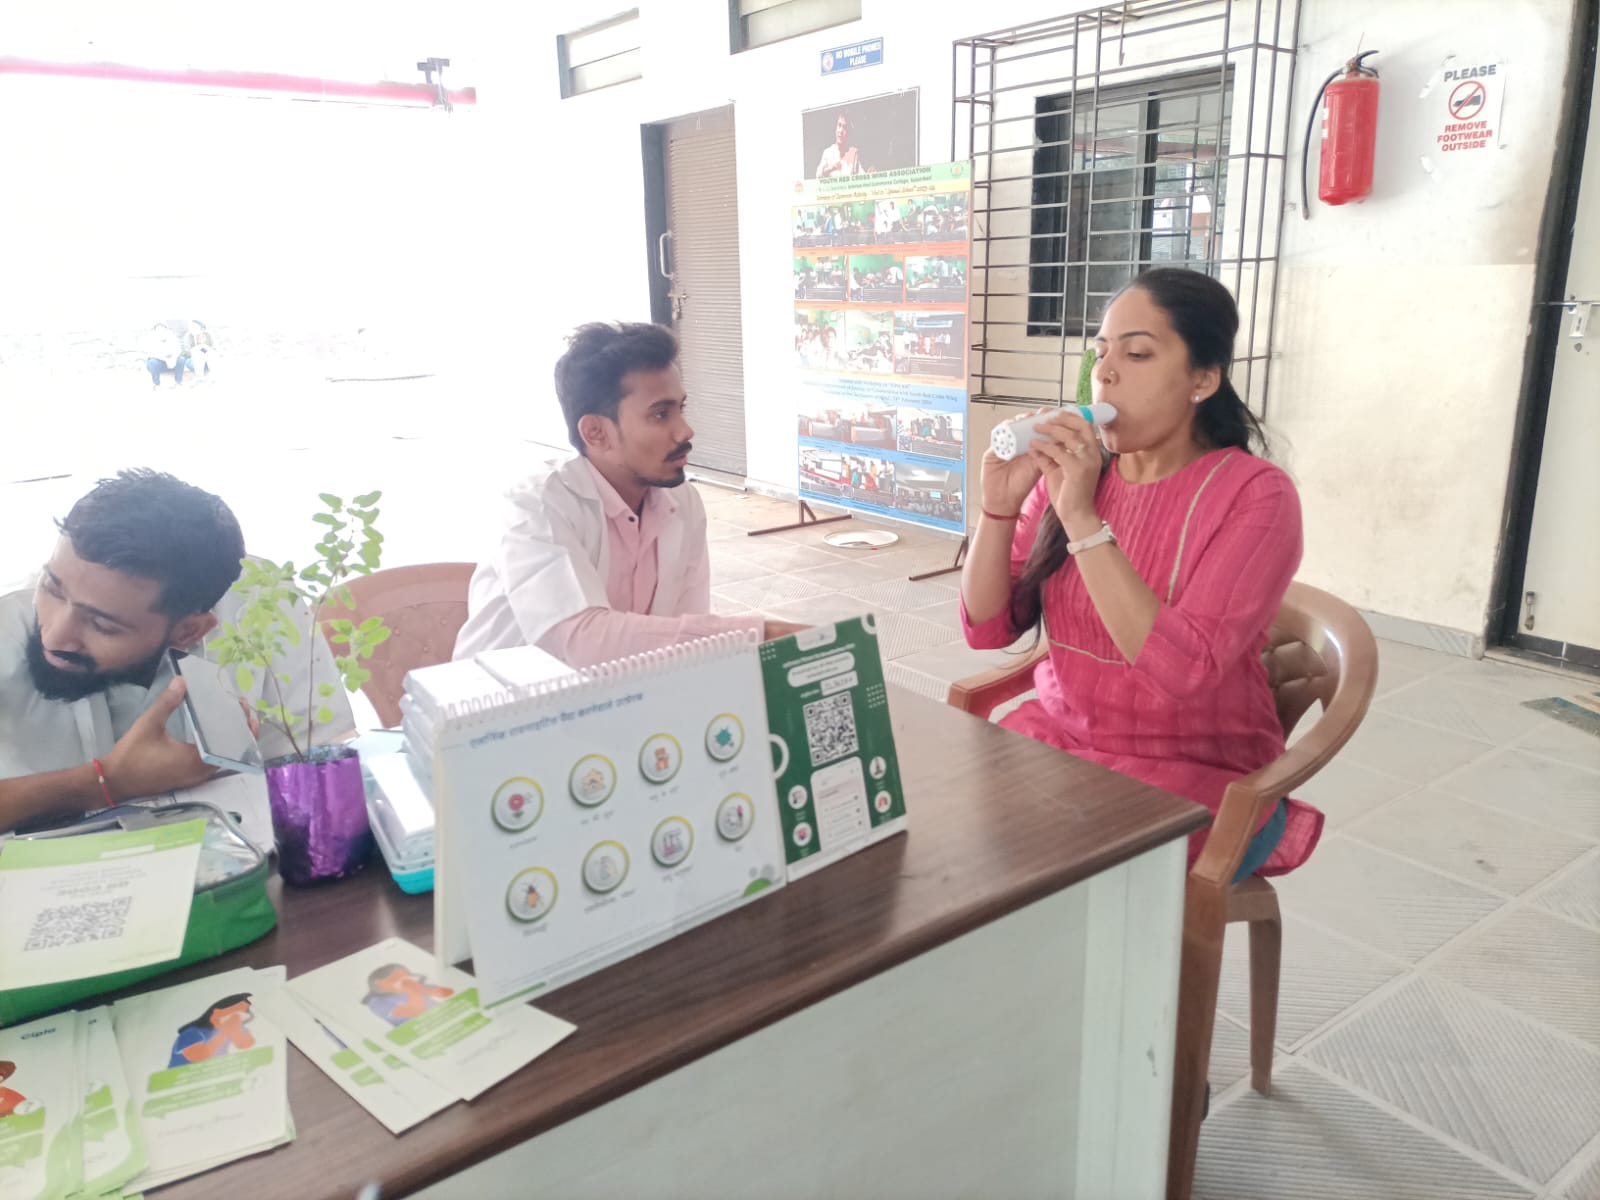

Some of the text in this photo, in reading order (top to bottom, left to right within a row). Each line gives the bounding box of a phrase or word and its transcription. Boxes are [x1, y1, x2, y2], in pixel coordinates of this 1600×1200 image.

[1443, 64, 1497, 82] PLEASE
[1444, 120, 1488, 133] REMOVE
[1436, 129, 1493, 143] FOOTWEAR
[1441, 140, 1487, 152] OUTSIDE
[819, 177, 838, 185] YOUTH
[839, 175, 850, 183] RED
[852, 174, 871, 182] CROSS
[889, 167, 932, 177] ASSOCIATION
[20, 1027, 56, 1040] Cipla
